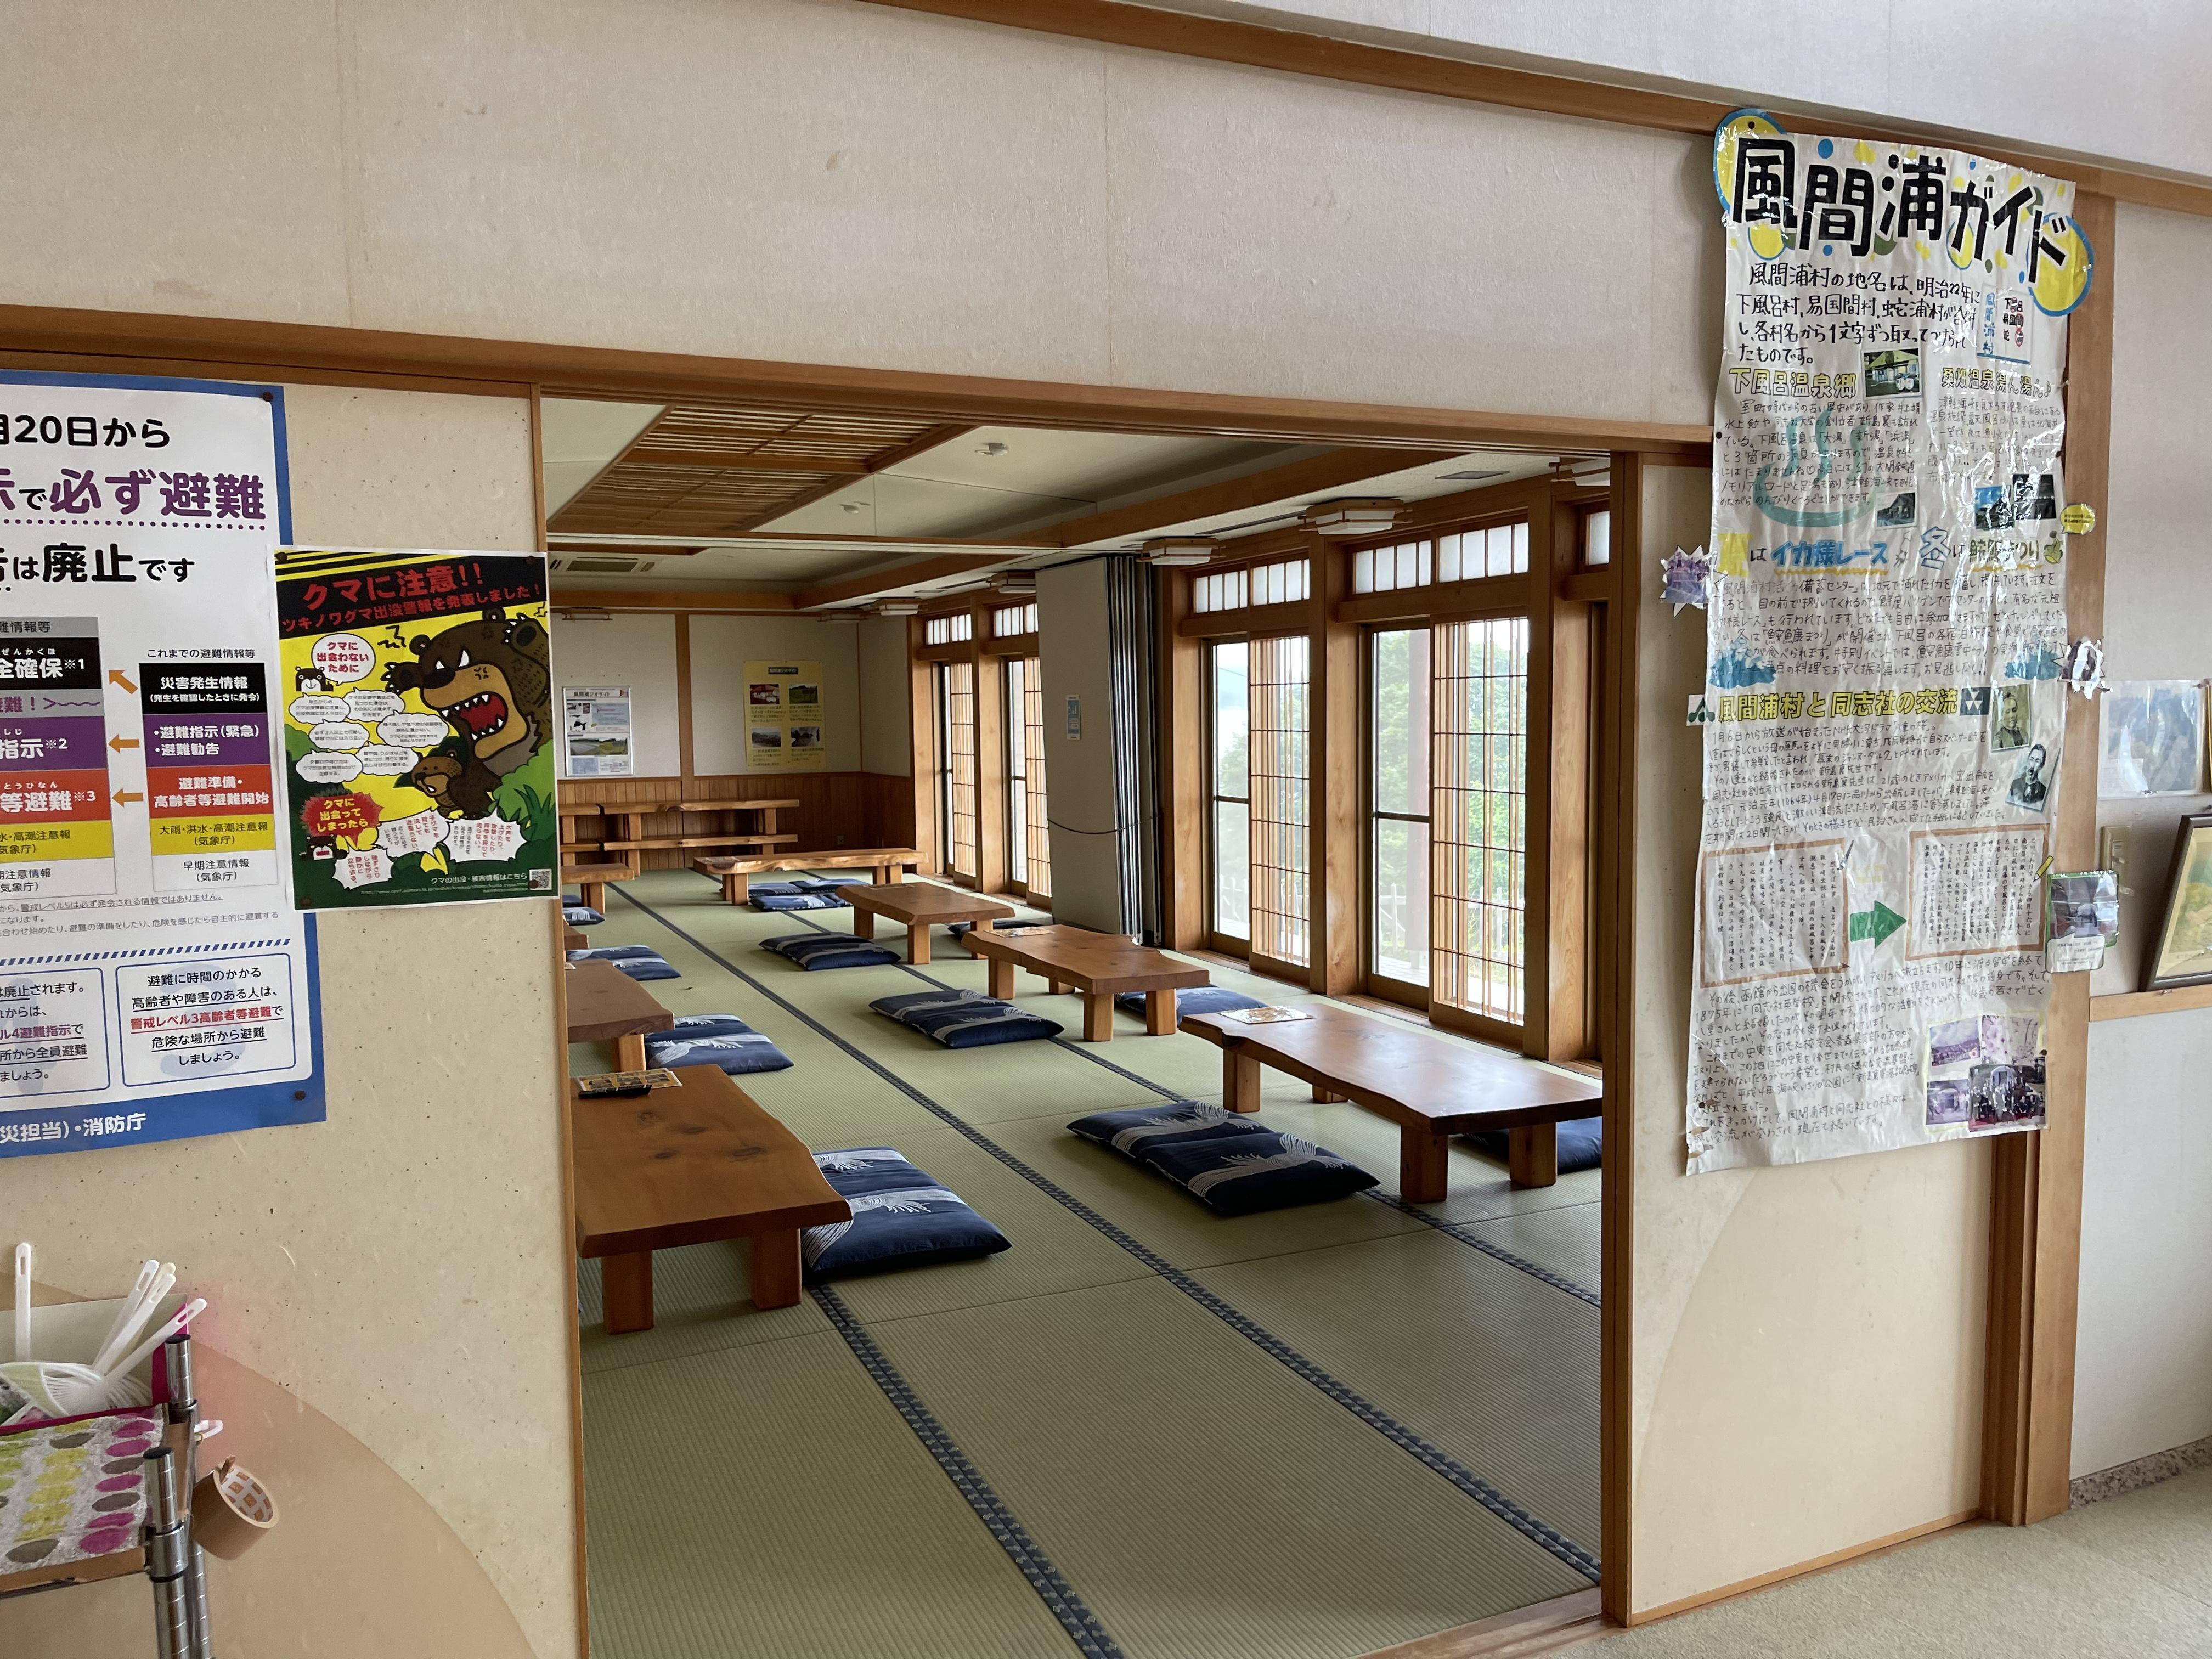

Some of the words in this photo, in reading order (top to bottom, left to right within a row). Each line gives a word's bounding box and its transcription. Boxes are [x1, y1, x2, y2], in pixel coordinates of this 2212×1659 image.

[1733, 138, 2066, 284] 風間浦ガイド
[1739, 343, 1813, 365] たものです。
[1729, 368, 1857, 398] 下風呂温泉郷
[0, 414, 170, 448] 20日から
[0, 543, 195, 582] は廃止です
[147, 648, 256, 658] これまでの避難情報等
[327, 641, 358, 651] クマに
[317, 653, 369, 662] 出会わない
[328, 664, 359, 673] ために
[161, 676, 248, 690] 災害発生情報
[0, 696, 35, 712] 難！
[150, 693, 259, 702] （発生を確認したときに発令）
[1718, 689, 1958, 722] 風間浦村と同志社の交流
[4, 781, 58, 789] とうひなん
[154, 792, 269, 808] 高齢者等避難開始
[324, 798, 356, 809] クマに
[320, 808, 362, 821] 出会って
[159, 822, 268, 835] 大雨・洪水・高潮注意報
[317, 819, 368, 833] しまったら
[194, 836, 235, 846] （気象庁）
[183, 859, 250, 871] 早期注意情報
[197, 871, 238, 883] （気象庁）
[148, 967, 262, 987] 避難に時間のかかる
[132, 986, 278, 1009] 高齢者や障害のある人は、
[0, 1007, 47, 1019] からは、
[131, 1006, 283, 1030] 警戒レベル3高齢者等避難で
[151, 1026, 266, 1048] 危険な場所から避難
[179, 1052, 240, 1066] しましょう。
